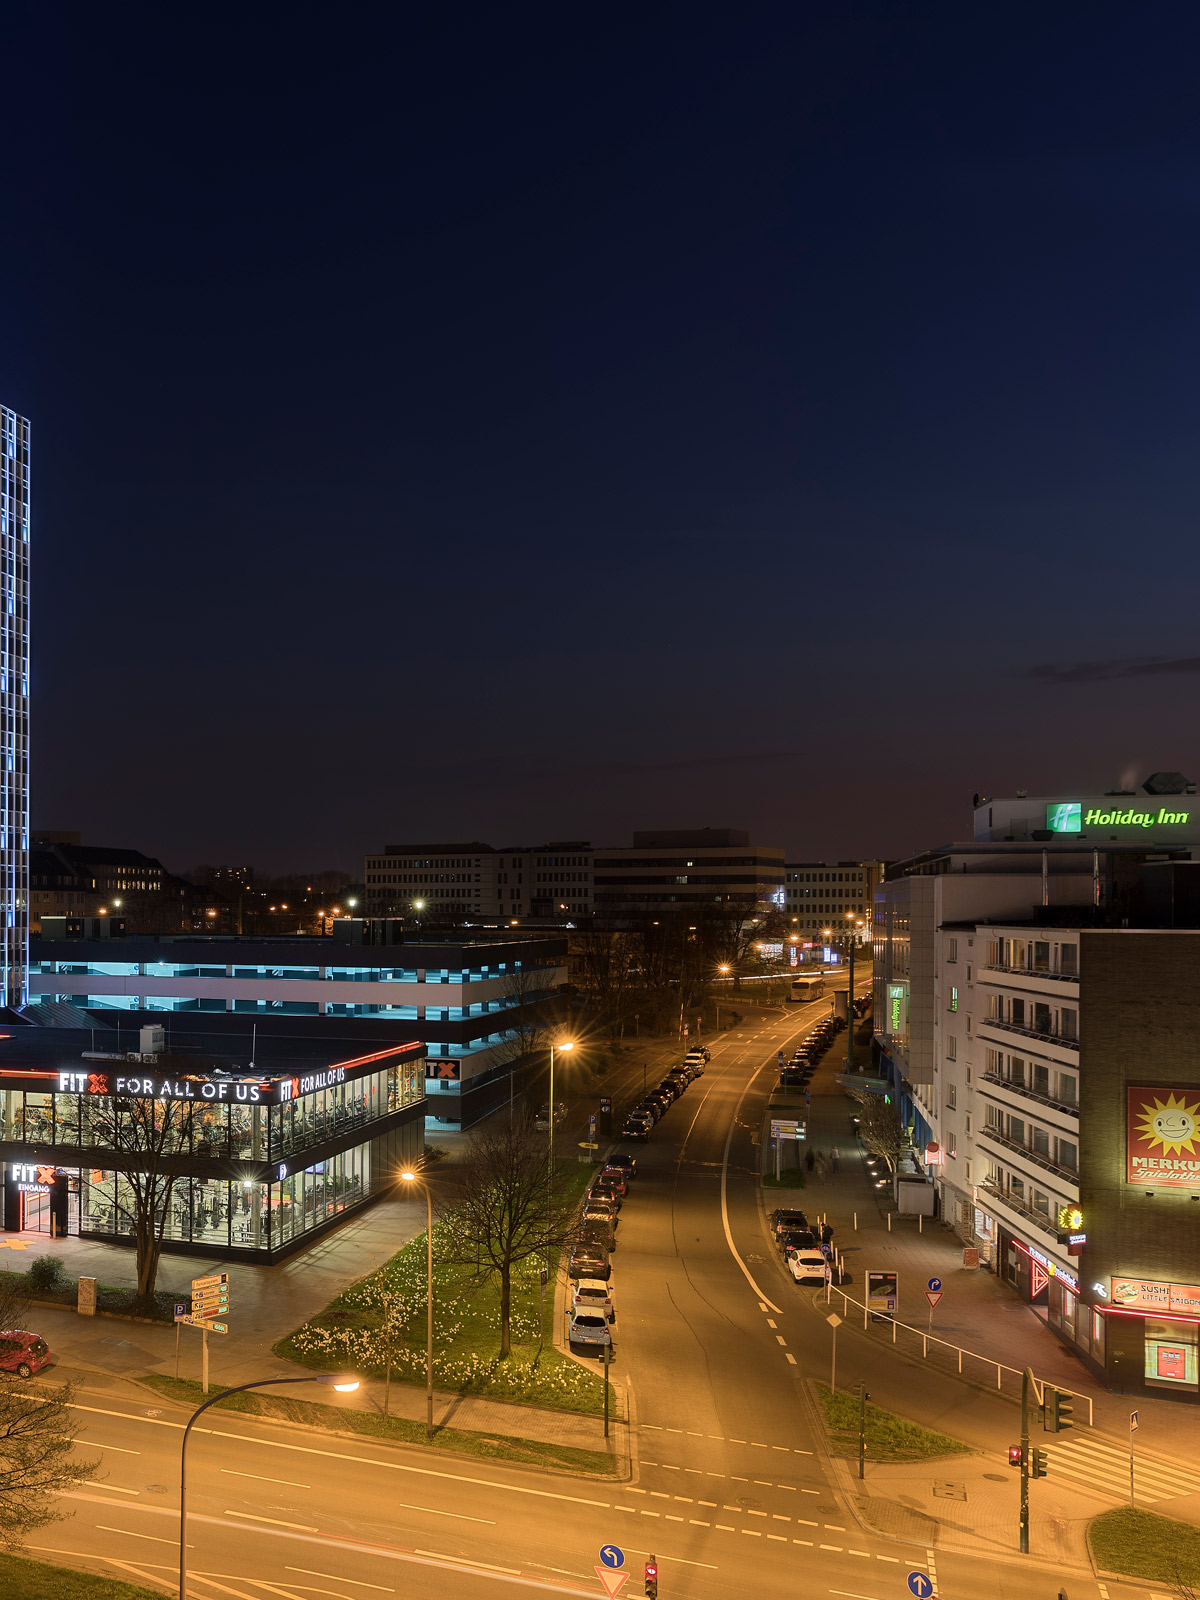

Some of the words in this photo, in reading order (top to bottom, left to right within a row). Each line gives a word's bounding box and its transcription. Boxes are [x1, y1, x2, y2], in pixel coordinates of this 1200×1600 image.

[1084, 809, 1155, 828] Holiday
[1158, 808, 1189, 824] Inn
[892, 999, 900, 1020] Holiday
[300, 1076, 314, 1093] FOR
[315, 1072, 326, 1089] ALL
[328, 1069, 336, 1084] OF
[337, 1067, 345, 1081] US
[116, 1077, 153, 1094] FOR
[160, 1080, 195, 1097] ALL
[202, 1083, 227, 1099] OF
[236, 1084, 260, 1102] US
[1132, 1156, 1200, 1171] MERKU
[18, 1184, 50, 1192] EINGANG
[1140, 1284, 1169, 1294] SUSHI
[1142, 1294, 1168, 1302] LITTLE
